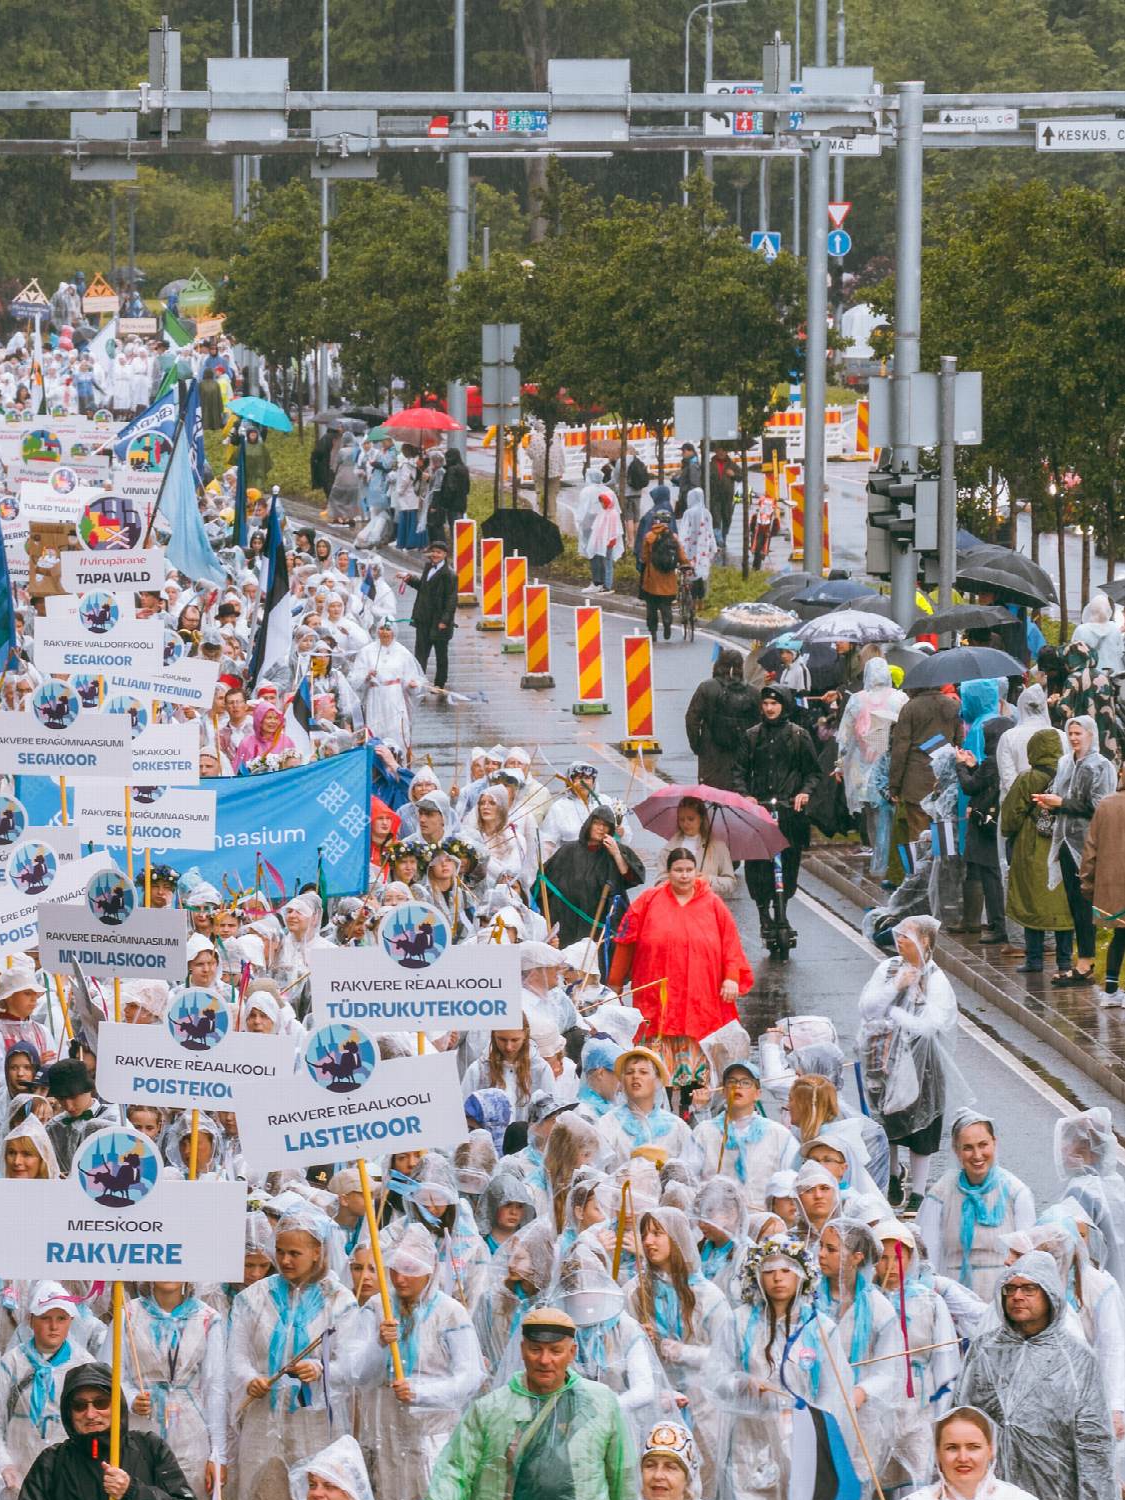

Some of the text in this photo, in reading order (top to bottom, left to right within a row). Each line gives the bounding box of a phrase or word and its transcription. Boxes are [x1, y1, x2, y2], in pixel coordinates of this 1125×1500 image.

[1058, 129, 1111, 142] KESKUS,
[76, 571, 151, 585] TAPA VALD
[43, 639, 154, 650] RAKVERE WALDORFKOOLI
[64, 653, 132, 666] SEGAKOOR
[111, 676, 151, 691] LILIANI
[153, 682, 203, 699] TRENNID
[18, 752, 97, 766] SEGAKOOR
[132, 748, 181, 756] SIKAKOOLI
[132, 761, 193, 771] ORKESTER
[81, 808, 122, 818] RAKVERE
[45, 931, 179, 947] RAKVERE ERAGÜMNAASIUMI
[58, 949, 166, 968] MUDILASKOOR
[330, 978, 503, 992] RAKVERE REAALKOOLI
[326, 998, 508, 1018] TÜDRUKUTEKOOR
[115, 1055, 276, 1076] RAKVERE REAALKOOLI
[132, 1077, 233, 1098] POISTEKO
[267, 1092, 432, 1126] RAKVERE REAALKOOLI
[284, 1115, 423, 1152] LASTEKOOR
[67, 1219, 163, 1232] MEESKOOR
[46, 1242, 182, 1265] RAKVERE
